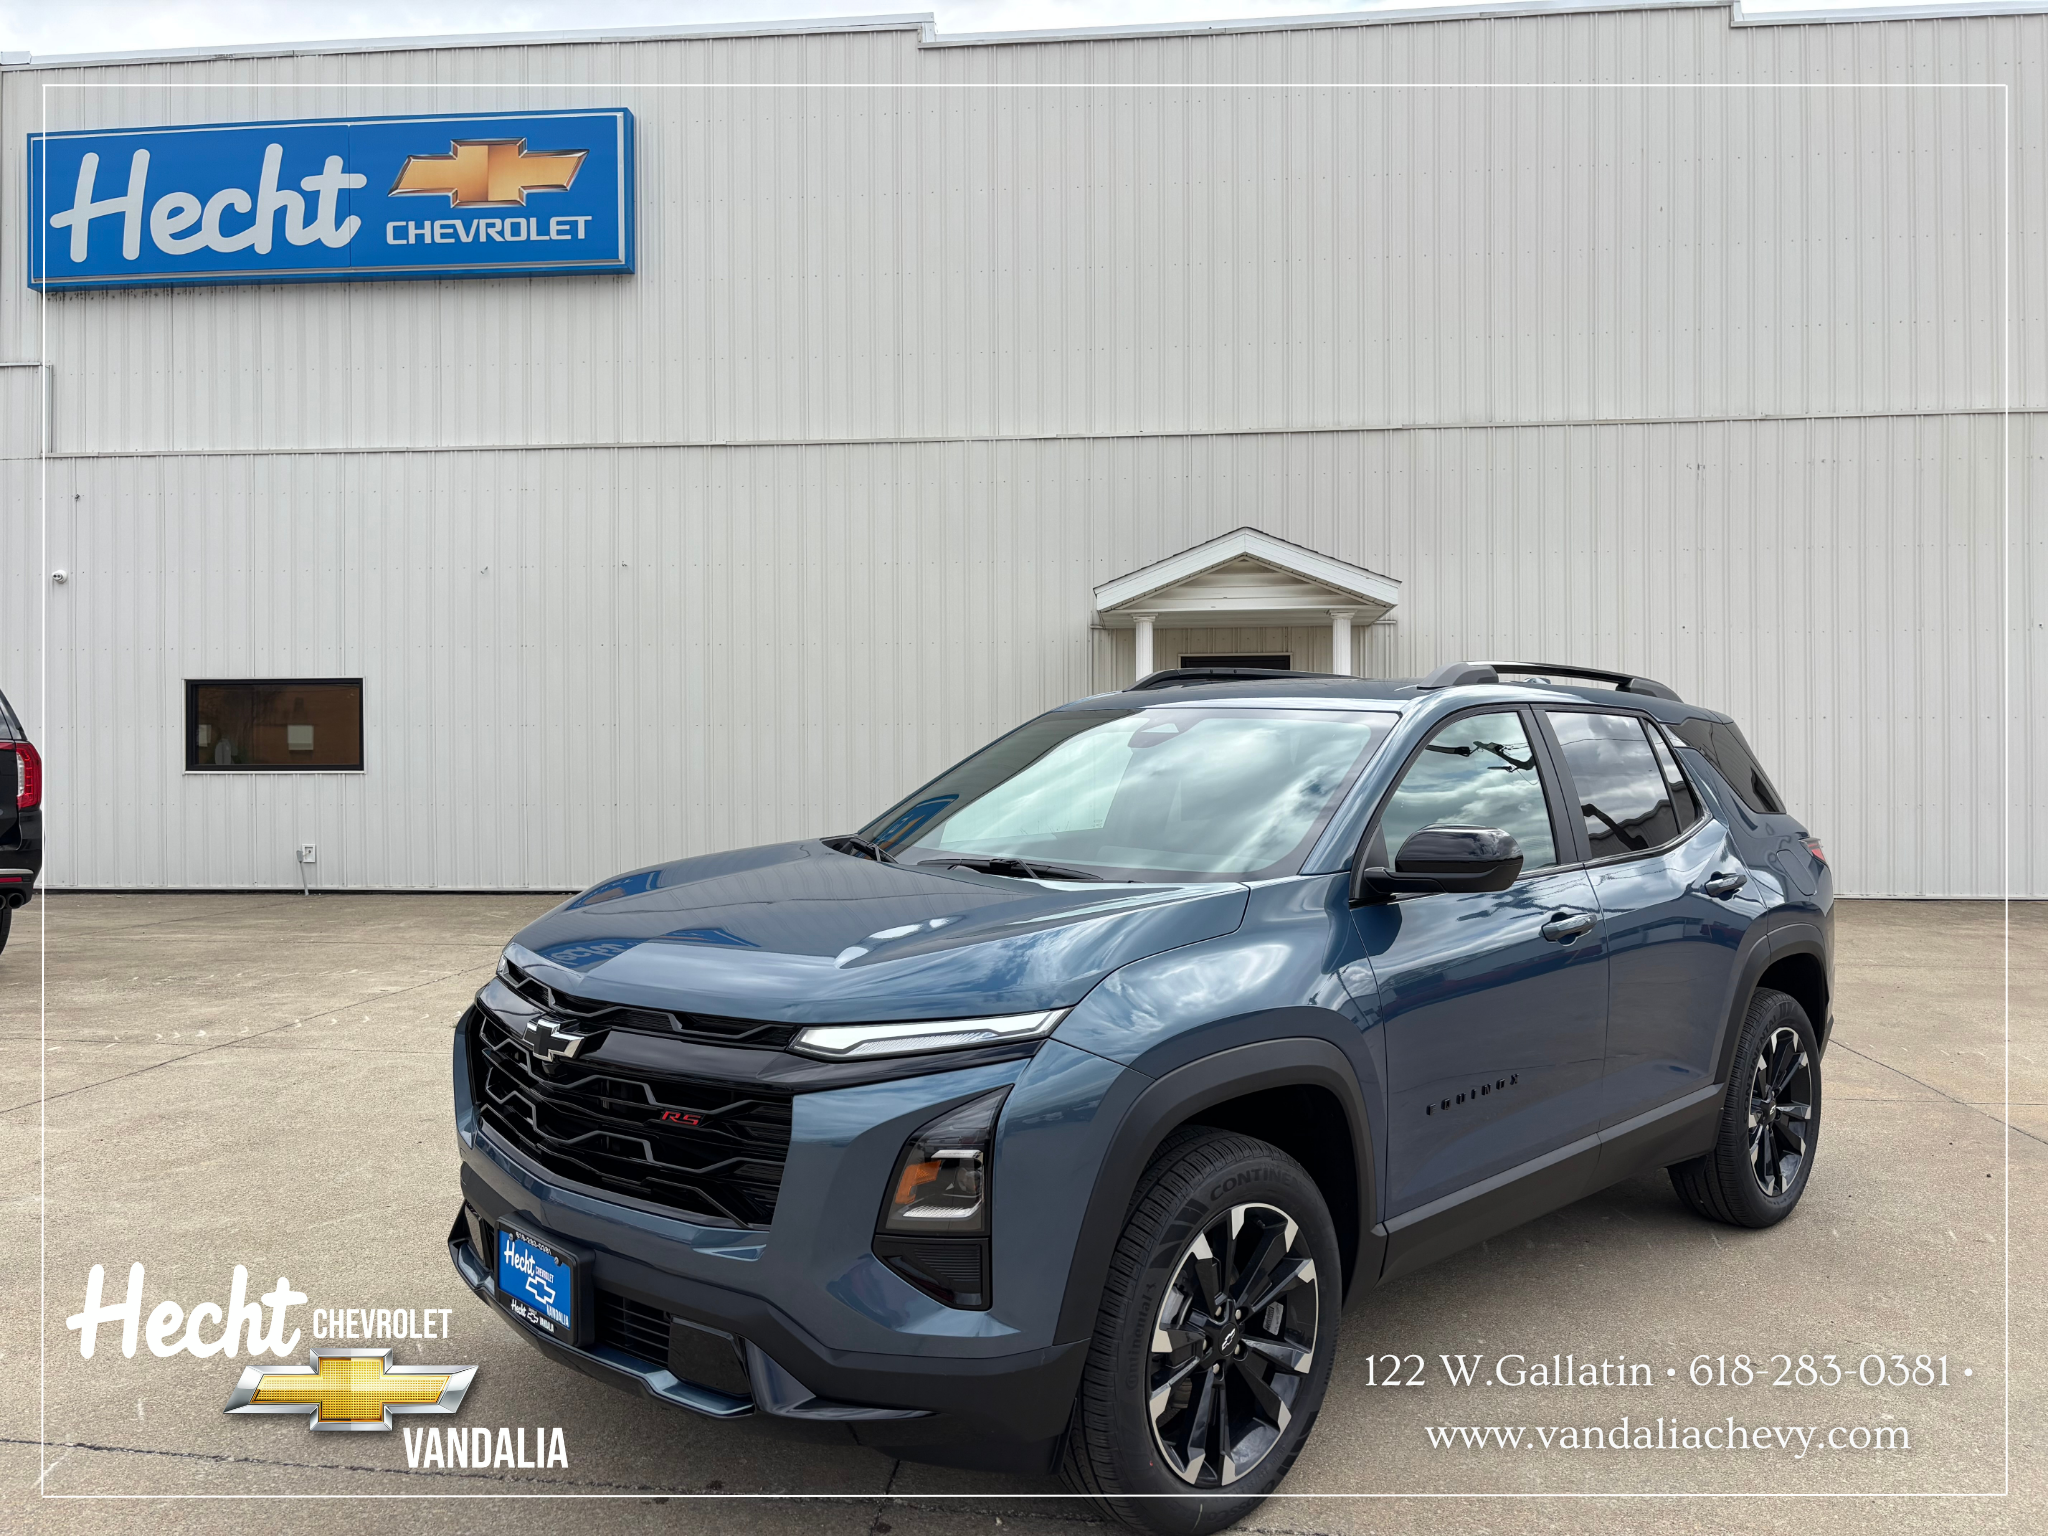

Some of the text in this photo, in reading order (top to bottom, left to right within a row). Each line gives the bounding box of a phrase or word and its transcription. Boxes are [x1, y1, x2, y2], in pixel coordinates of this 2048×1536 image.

[50, 143, 367, 262] Hecht
[386, 216, 592, 245] CHEVROLET
[661, 1111, 701, 1126] RS
[503, 1239, 536, 1276] Hecht
[535, 1266, 554, 1283] CHEVROLET
[511, 1299, 527, 1317] Hecht
[546, 1303, 569, 1328] VANDALIA
[1126, 1294, 1153, 1390] Continental
